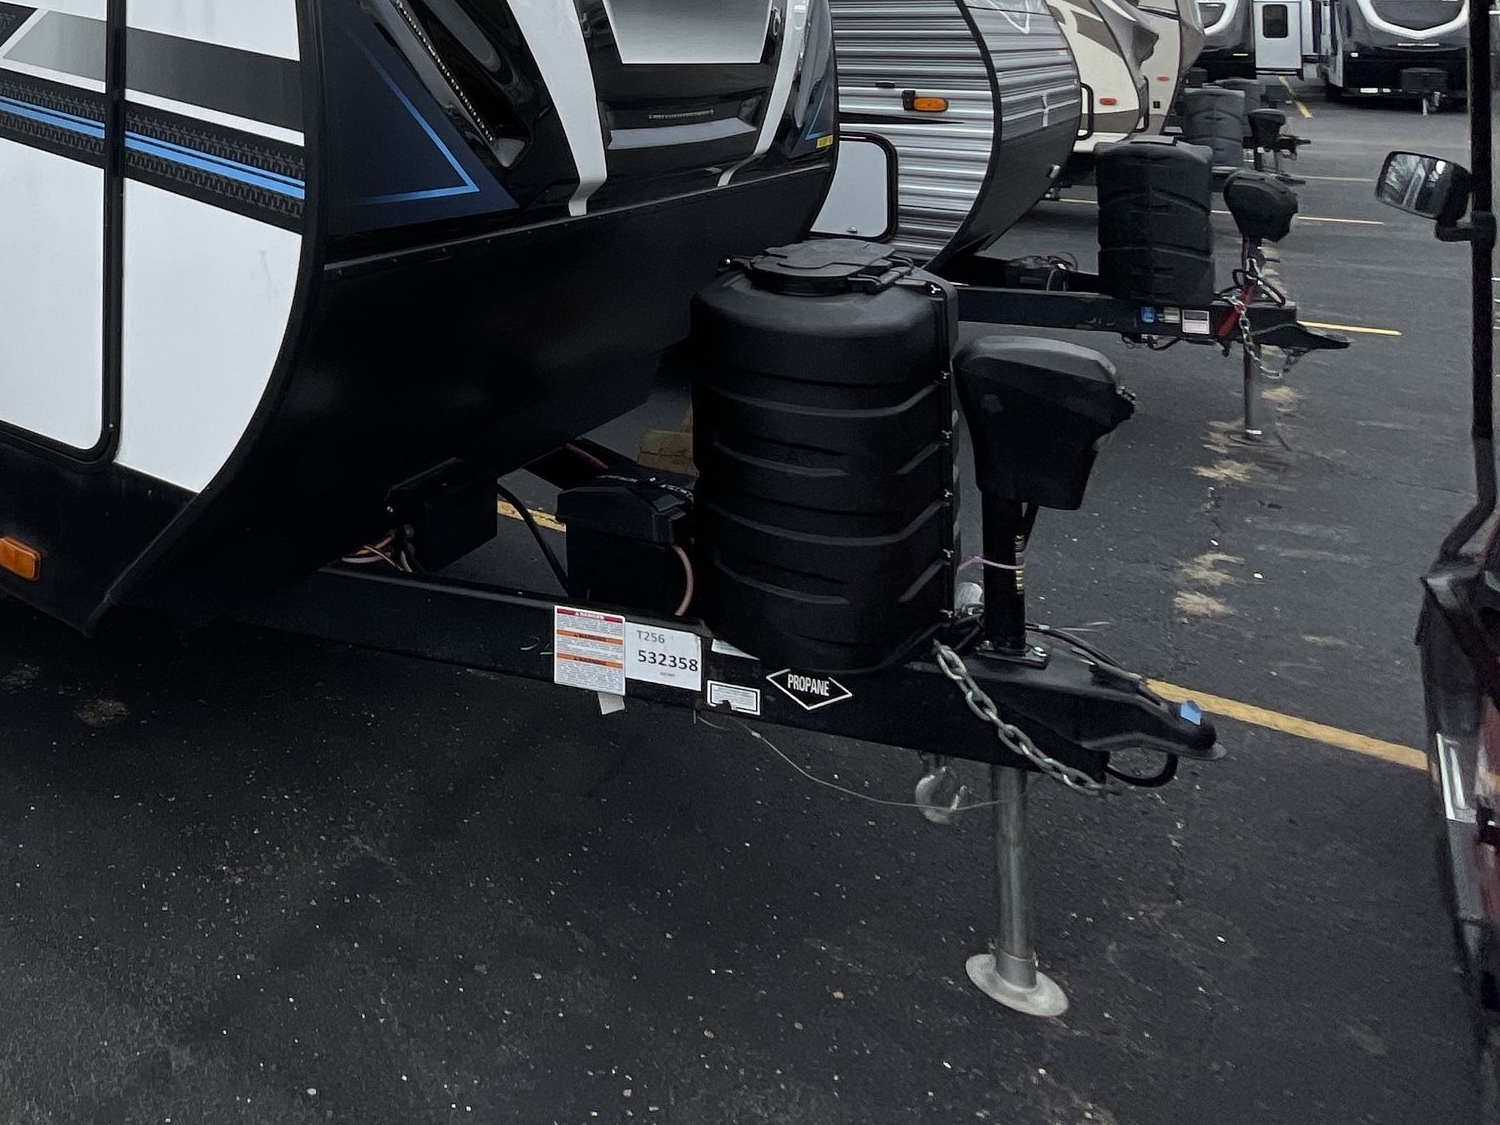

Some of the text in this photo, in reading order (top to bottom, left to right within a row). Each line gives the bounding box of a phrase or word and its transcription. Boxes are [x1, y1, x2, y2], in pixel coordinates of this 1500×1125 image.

[636, 629, 666, 644] T256
[637, 649, 699, 672] 532358
[786, 673, 831, 697] PROPANE
